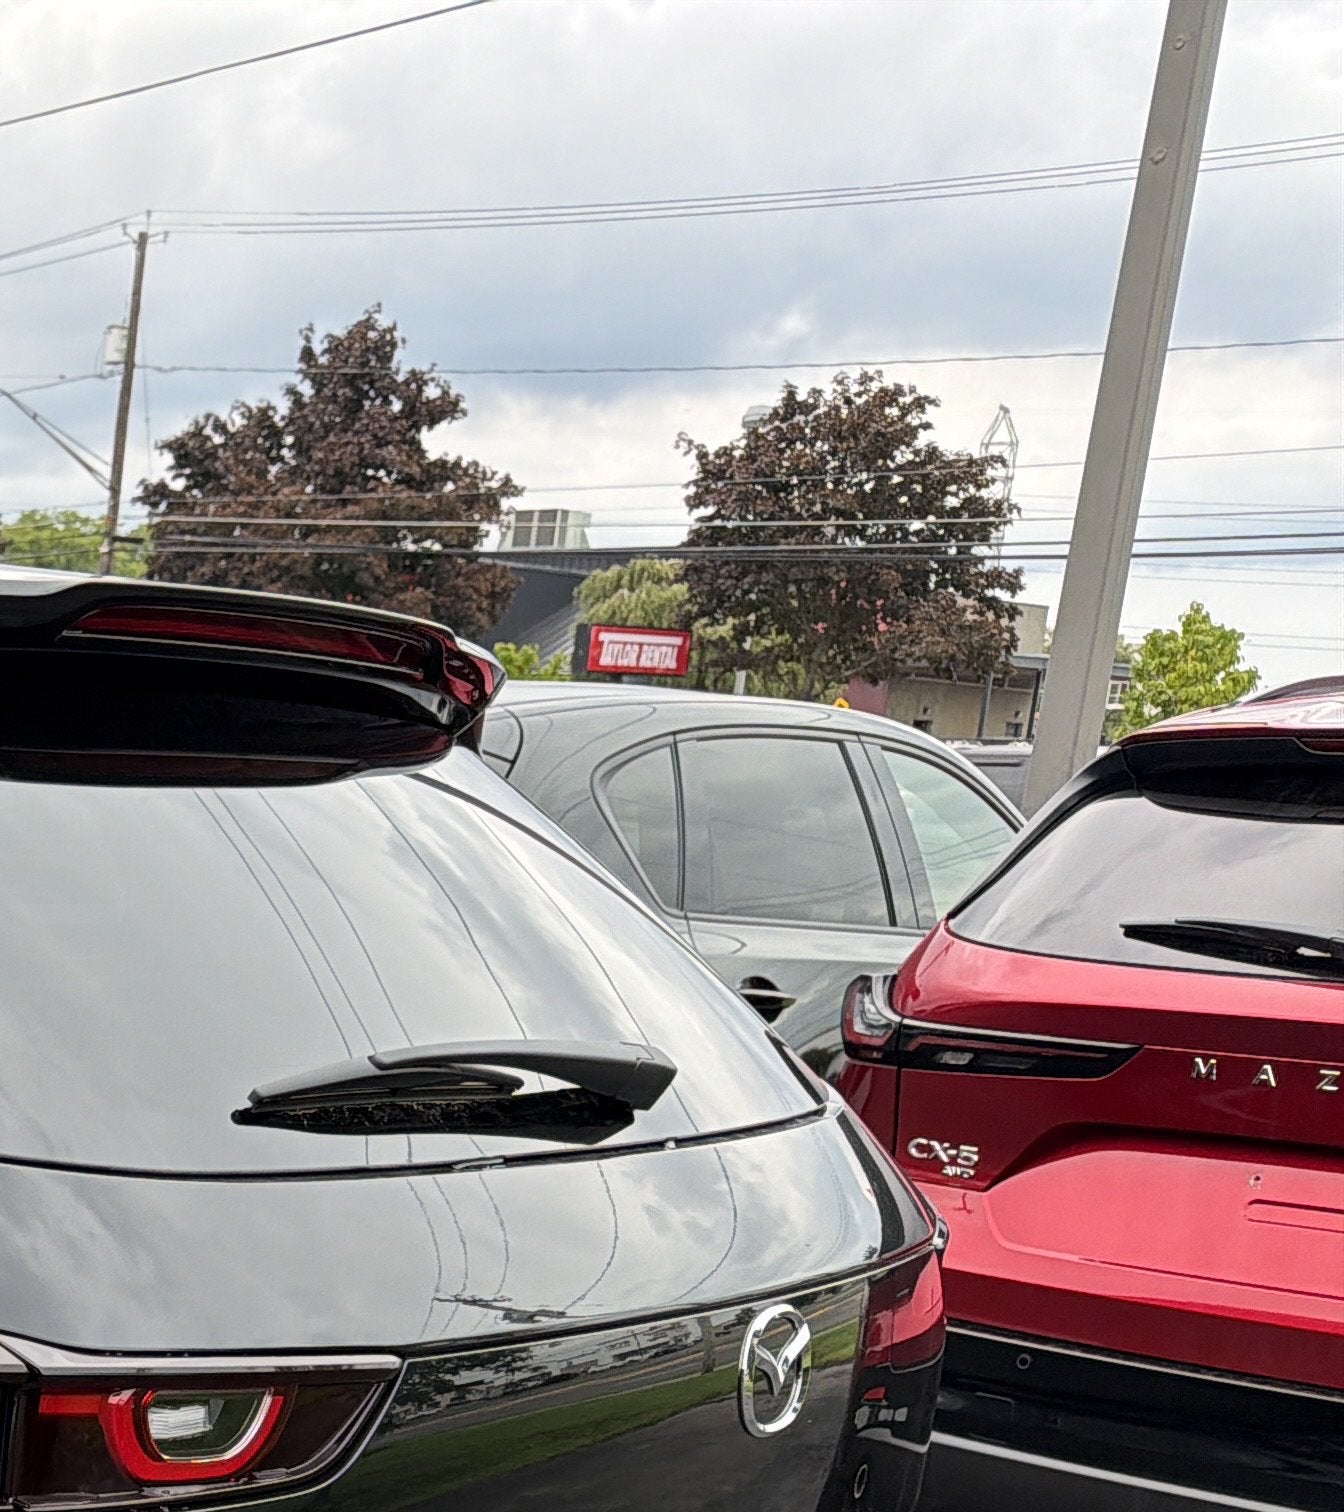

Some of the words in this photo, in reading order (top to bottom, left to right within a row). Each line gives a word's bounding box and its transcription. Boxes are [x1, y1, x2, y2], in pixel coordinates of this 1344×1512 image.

[598, 631, 640, 667] TAYLOR
[638, 643, 679, 669] RENTAL
[907, 1137, 979, 1167] CX-5
